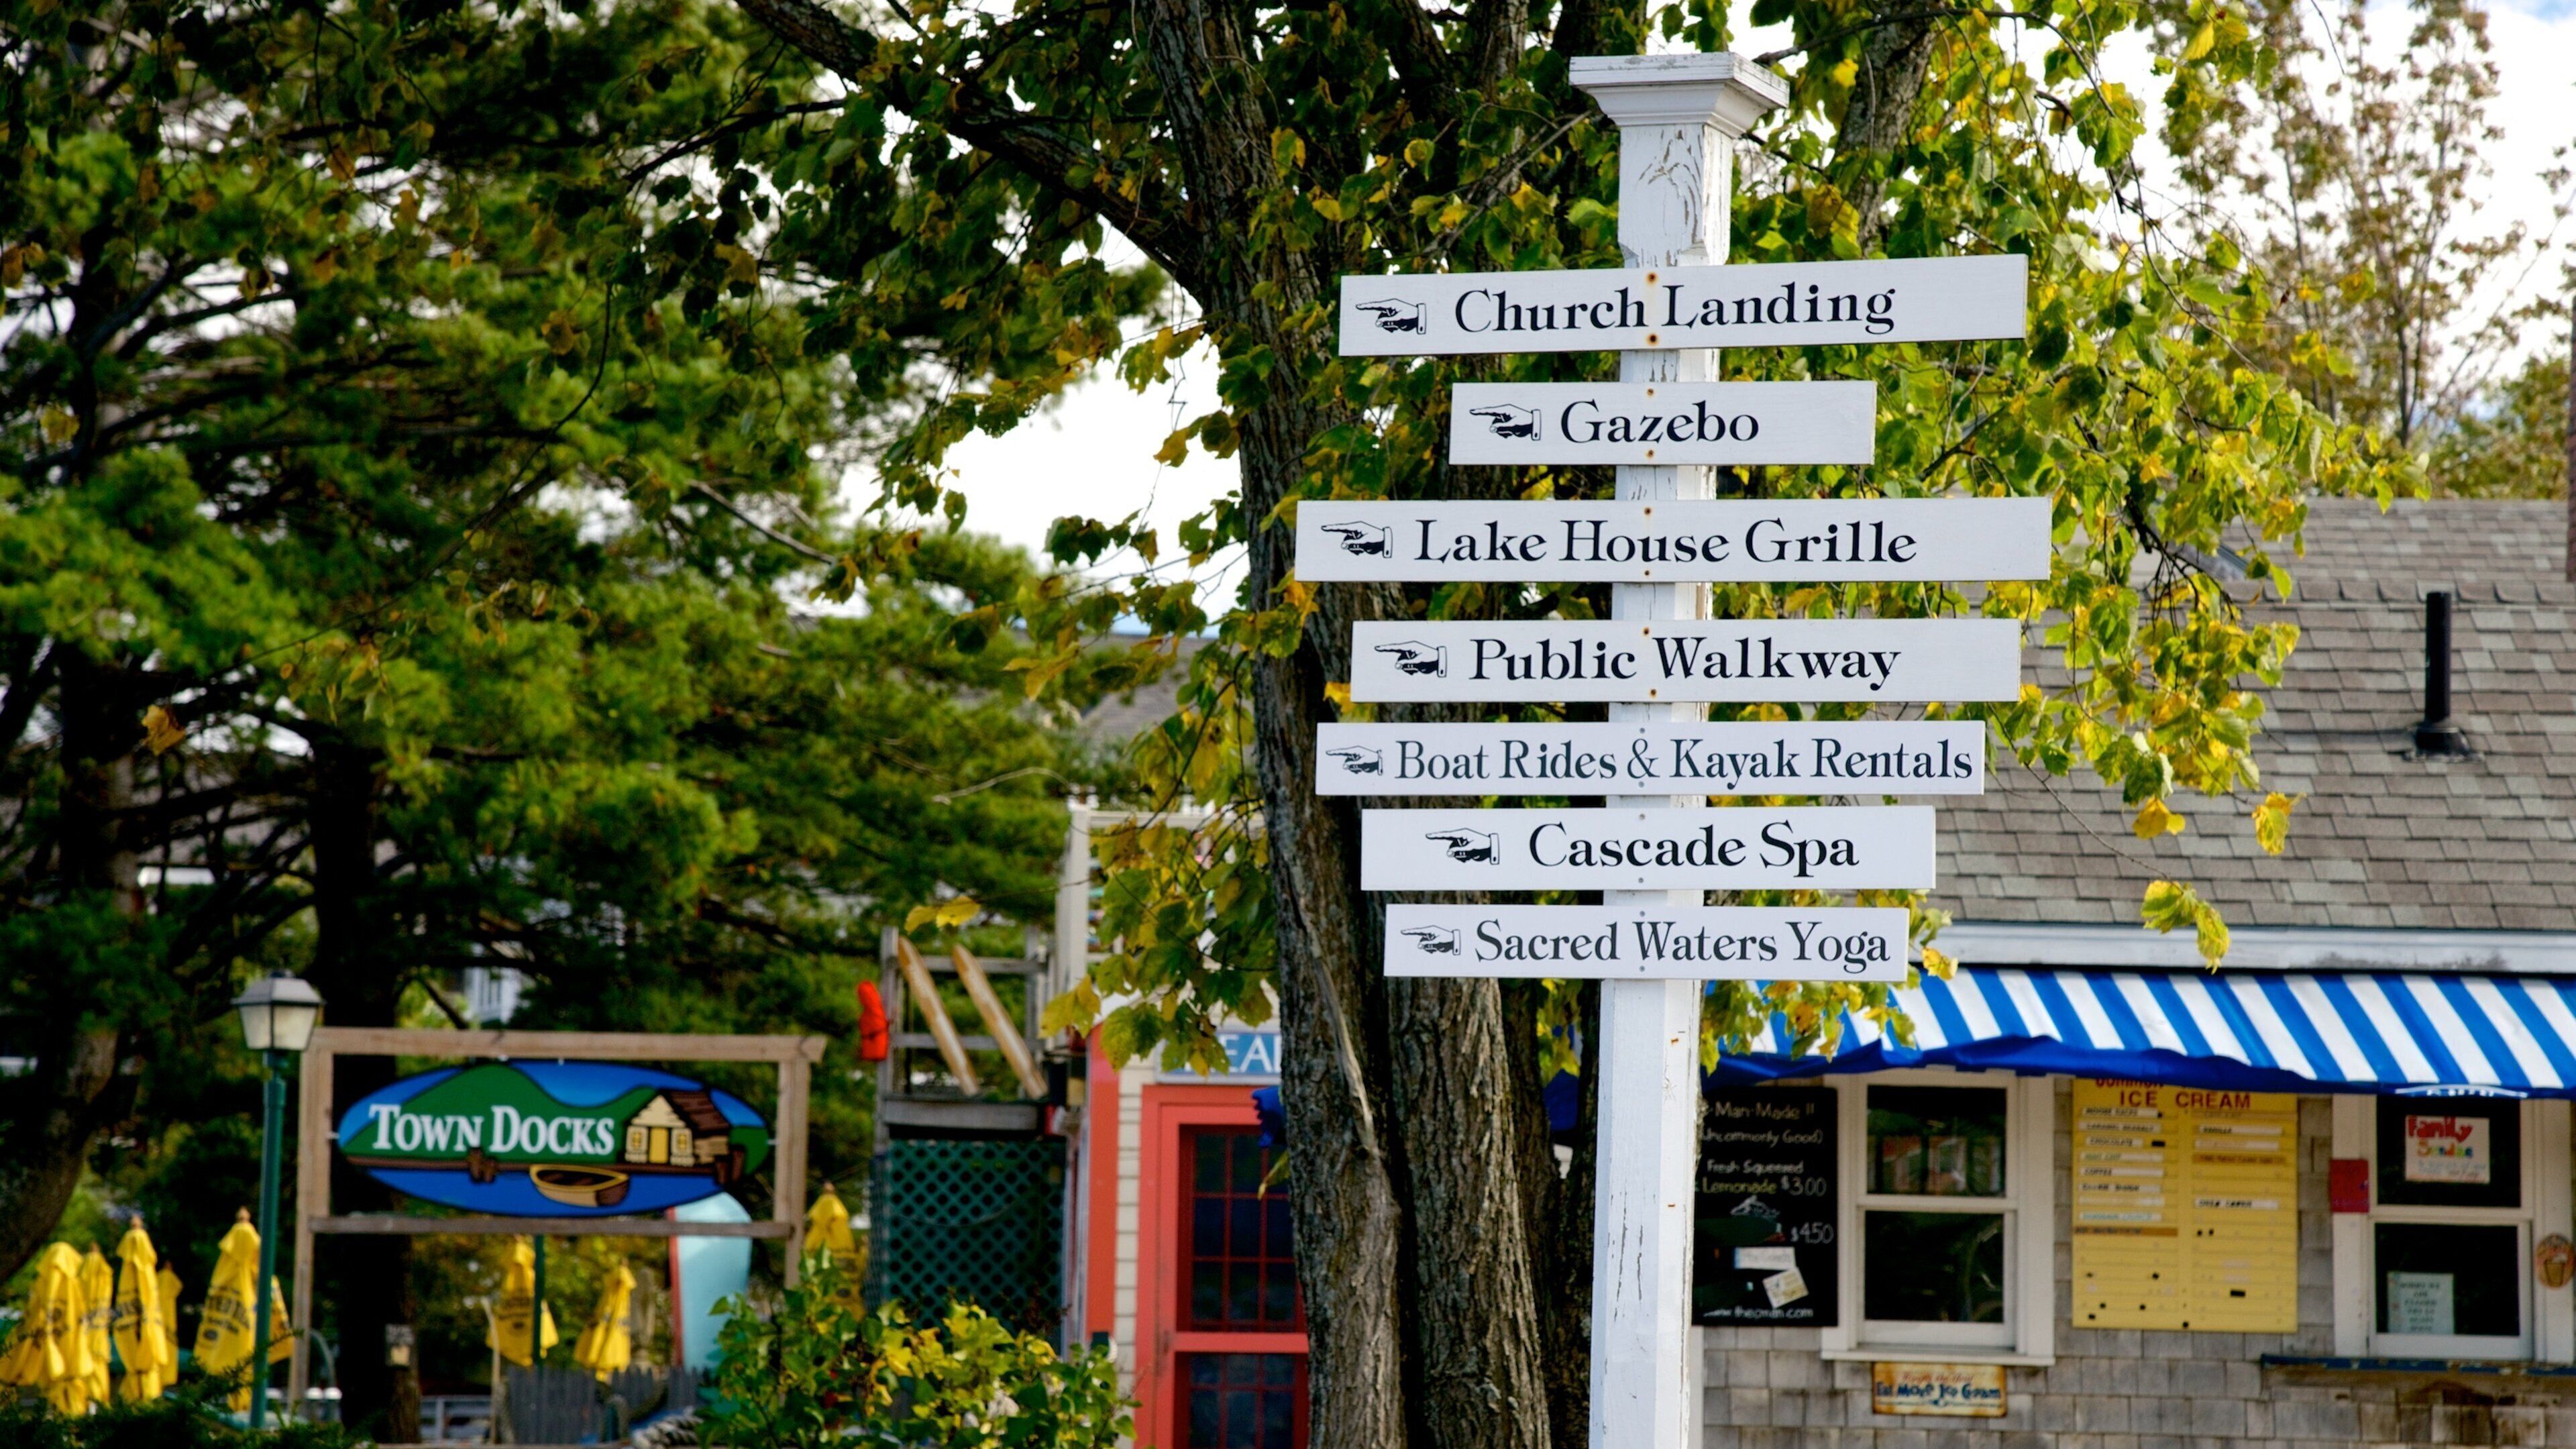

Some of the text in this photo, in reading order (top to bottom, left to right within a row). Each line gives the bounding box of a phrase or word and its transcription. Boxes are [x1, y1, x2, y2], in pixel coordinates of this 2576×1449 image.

[1455, 281, 1896, 335] Church Landing
[1560, 399, 1759, 443] Gazebo
[1414, 517, 1917, 564] Lake House Grille
[1469, 637, 1901, 691] Public Walkway
[1395, 739, 1973, 790] Boat Rides & Kayak Rentals
[1529, 820, 1860, 877] Cascade Spa
[1475, 920, 1890, 973] Sacred Waters Yoga
[2120, 1091, 2251, 1109] ICE CREAM
[2408, 1114, 2473, 1143] Family
[1702, 1176, 1778, 1194] Lemonade
